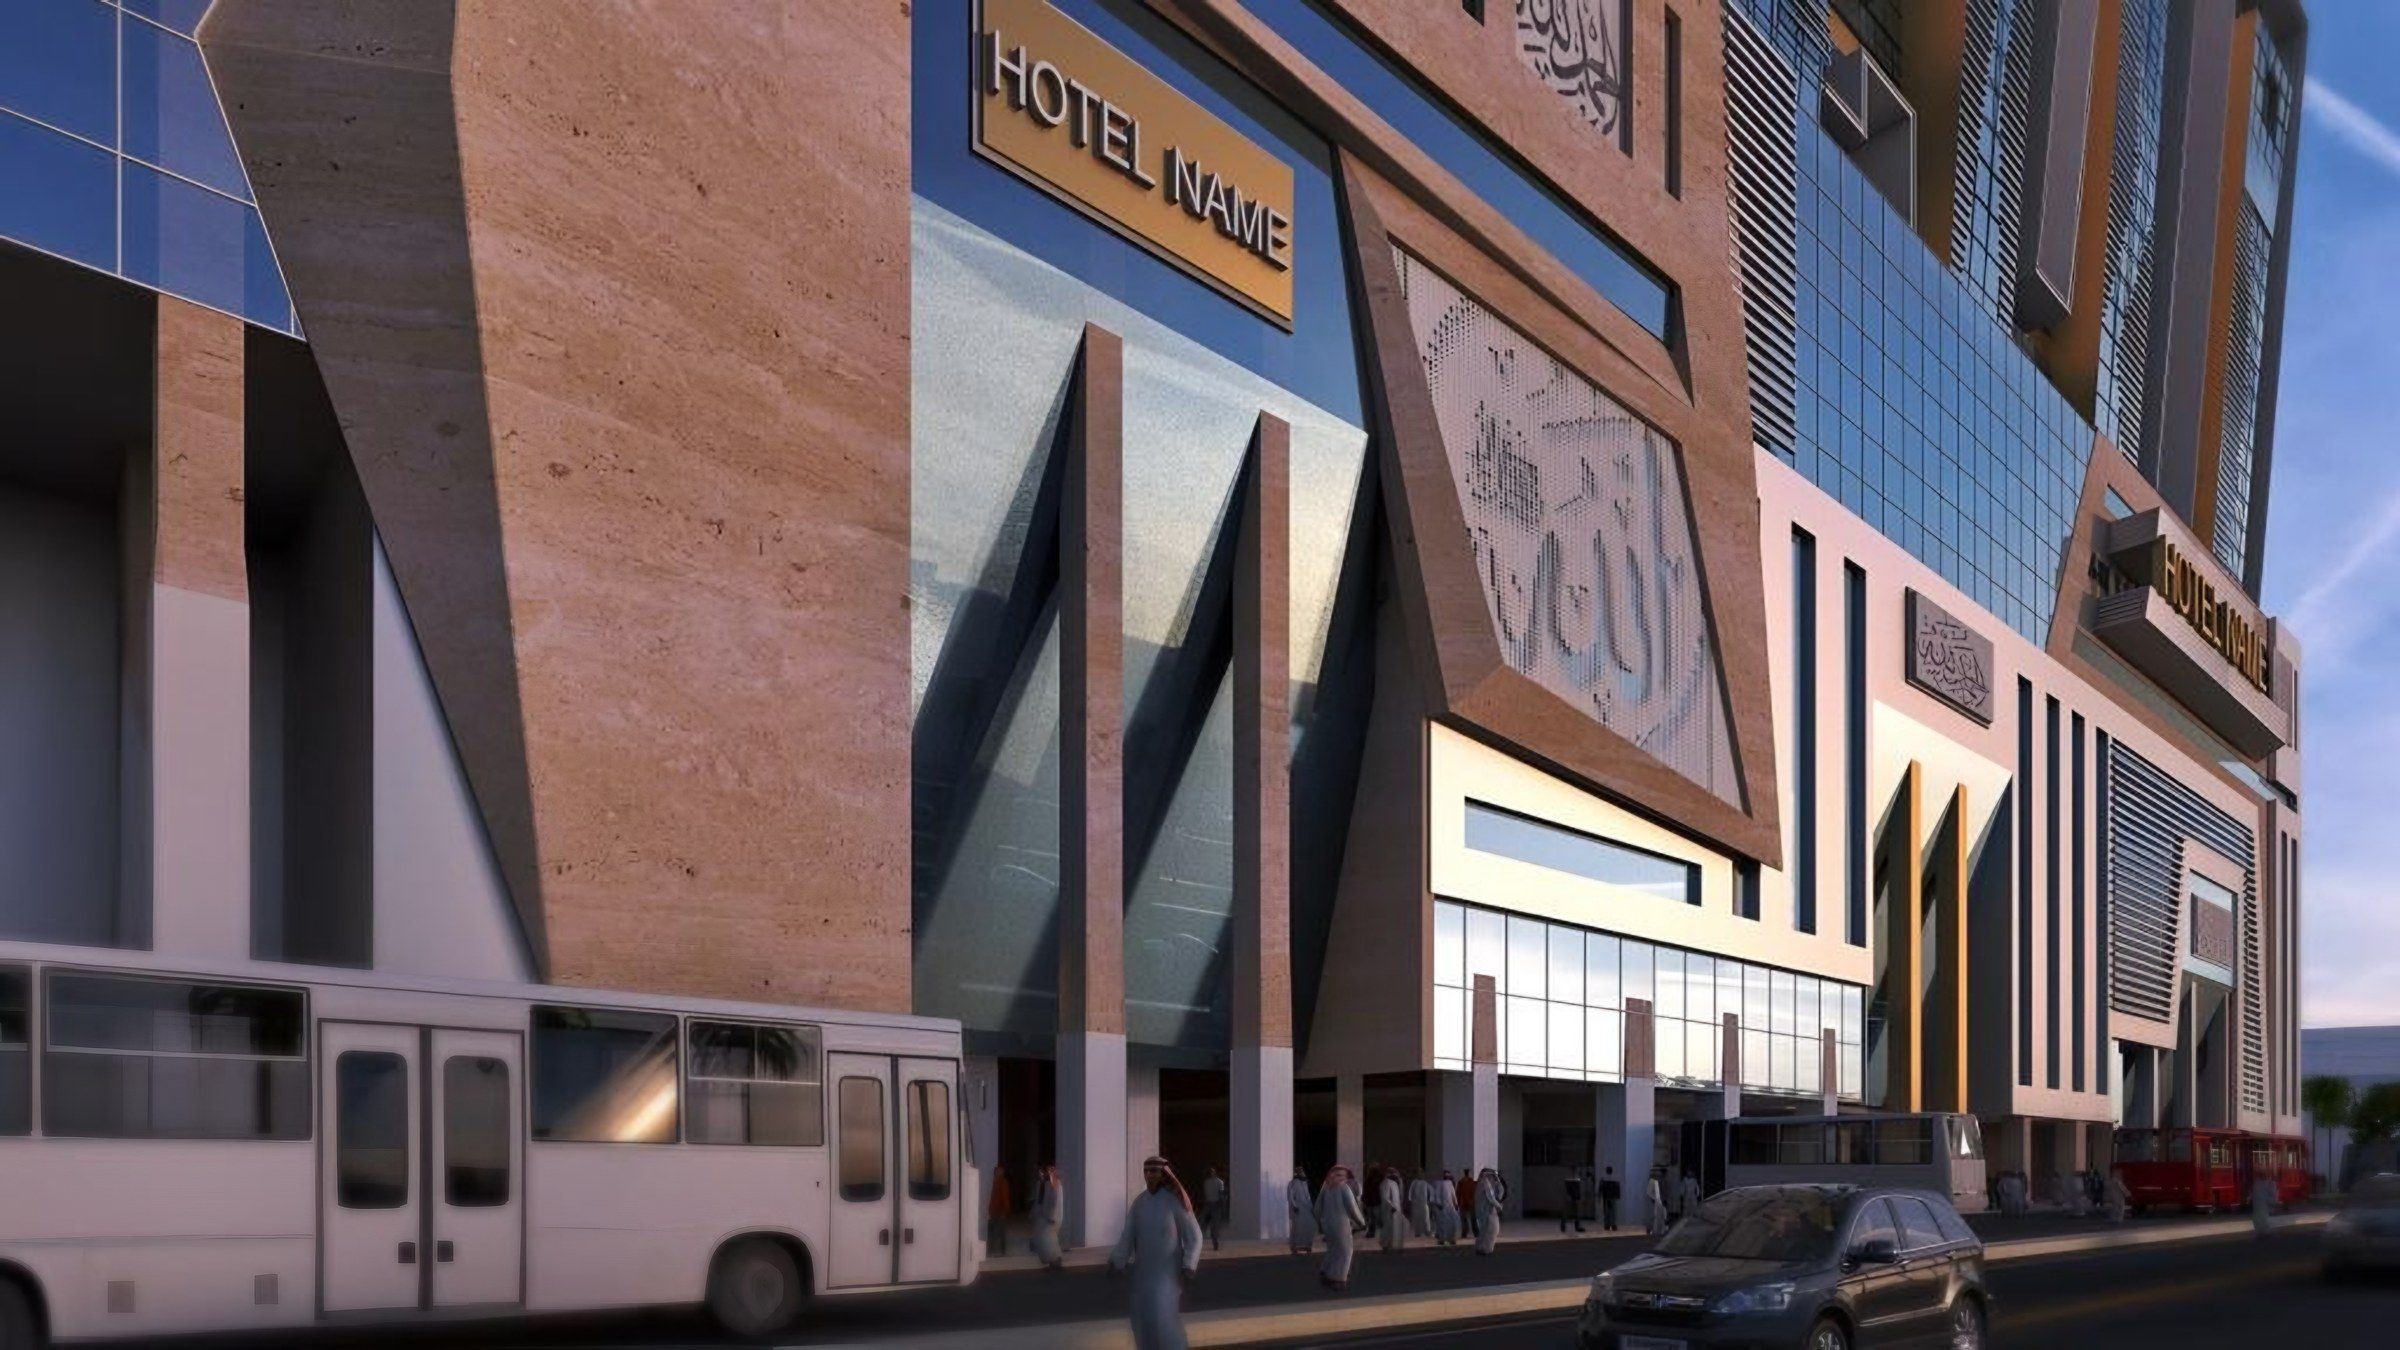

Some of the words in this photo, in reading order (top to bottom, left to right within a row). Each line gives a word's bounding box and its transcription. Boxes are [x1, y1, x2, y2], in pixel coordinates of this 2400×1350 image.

[988, 29, 1156, 189] HOTEL
[1166, 145, 1289, 271] NAME
[2161, 536, 2221, 648] HOTEL
[2224, 601, 2268, 692] NAME
